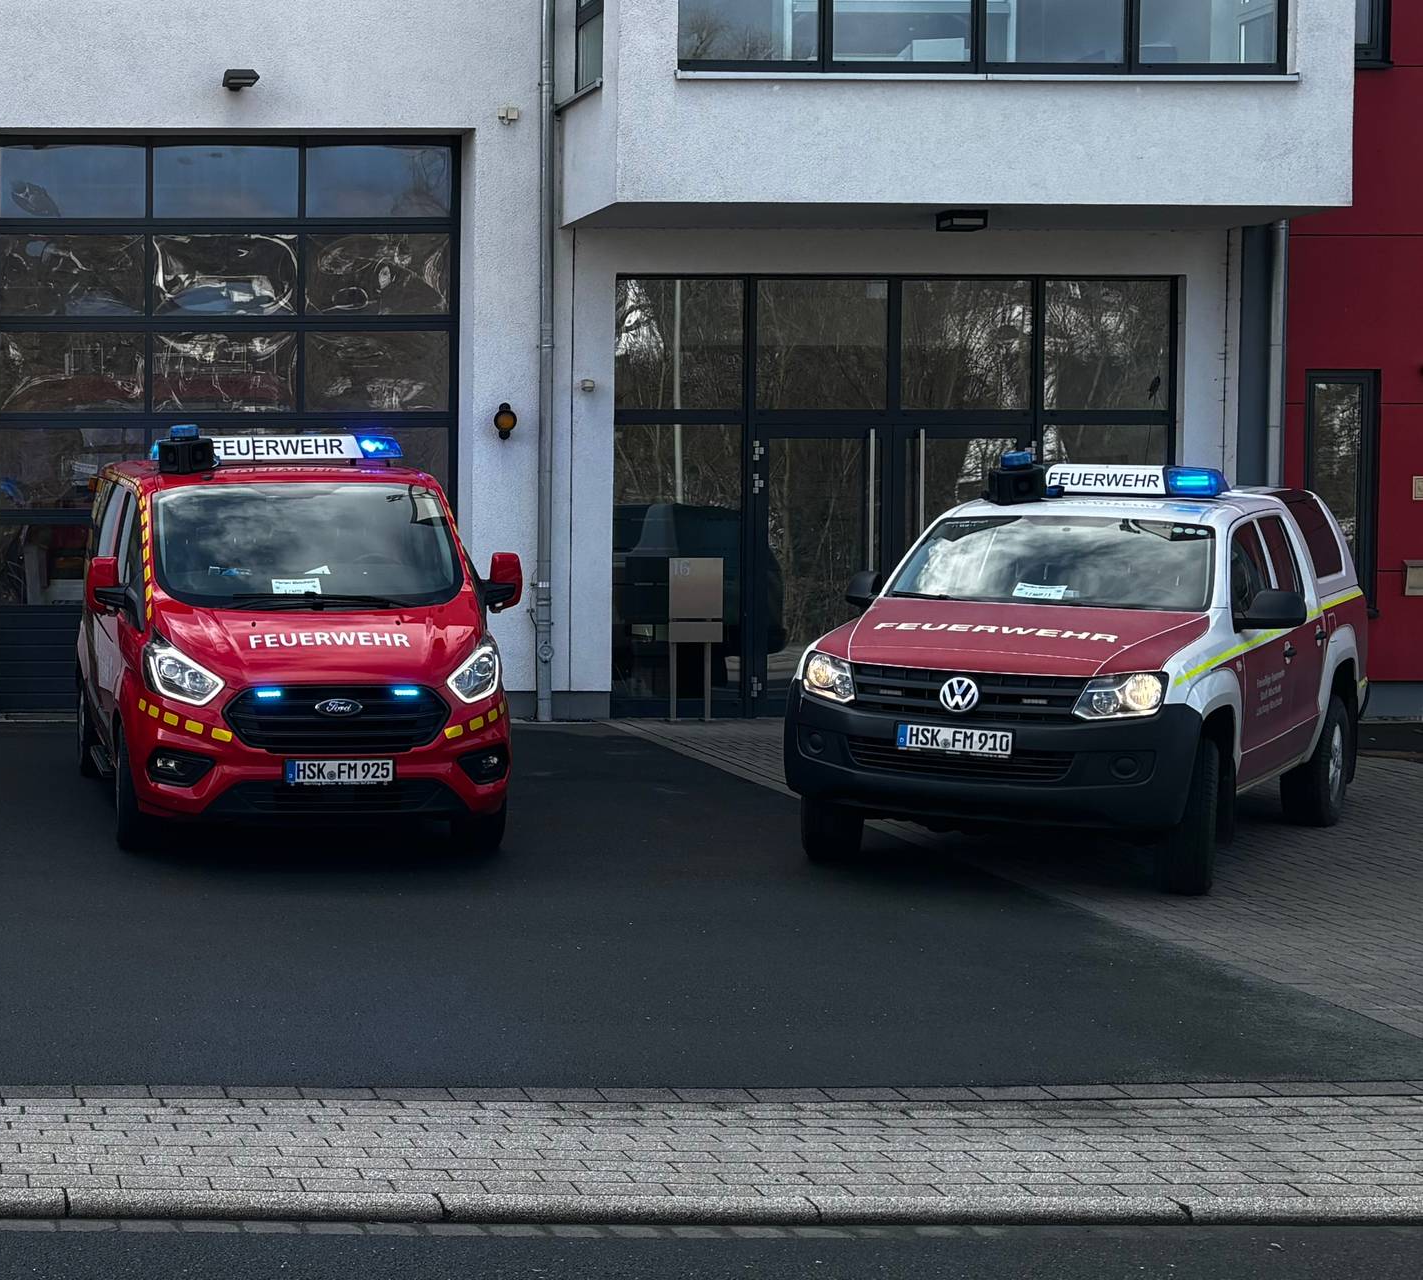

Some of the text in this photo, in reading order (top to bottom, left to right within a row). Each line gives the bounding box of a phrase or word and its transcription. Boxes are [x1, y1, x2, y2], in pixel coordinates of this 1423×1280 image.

[1048, 472, 1160, 488] FEUERWEHR
[673, 560, 690, 576] 16
[249, 632, 411, 648] FEUERWEHR
[874, 622, 1119, 643] FEUERWEHR
[940, 677, 978, 712] VW
[326, 701, 352, 713] Ford
[908, 727, 941, 747] HSK
[952, 730, 974, 749] FM
[978, 732, 1009, 752] 910
[297, 762, 326, 780] HSK
[337, 762, 357, 780] FM
[361, 762, 390, 779] 925
